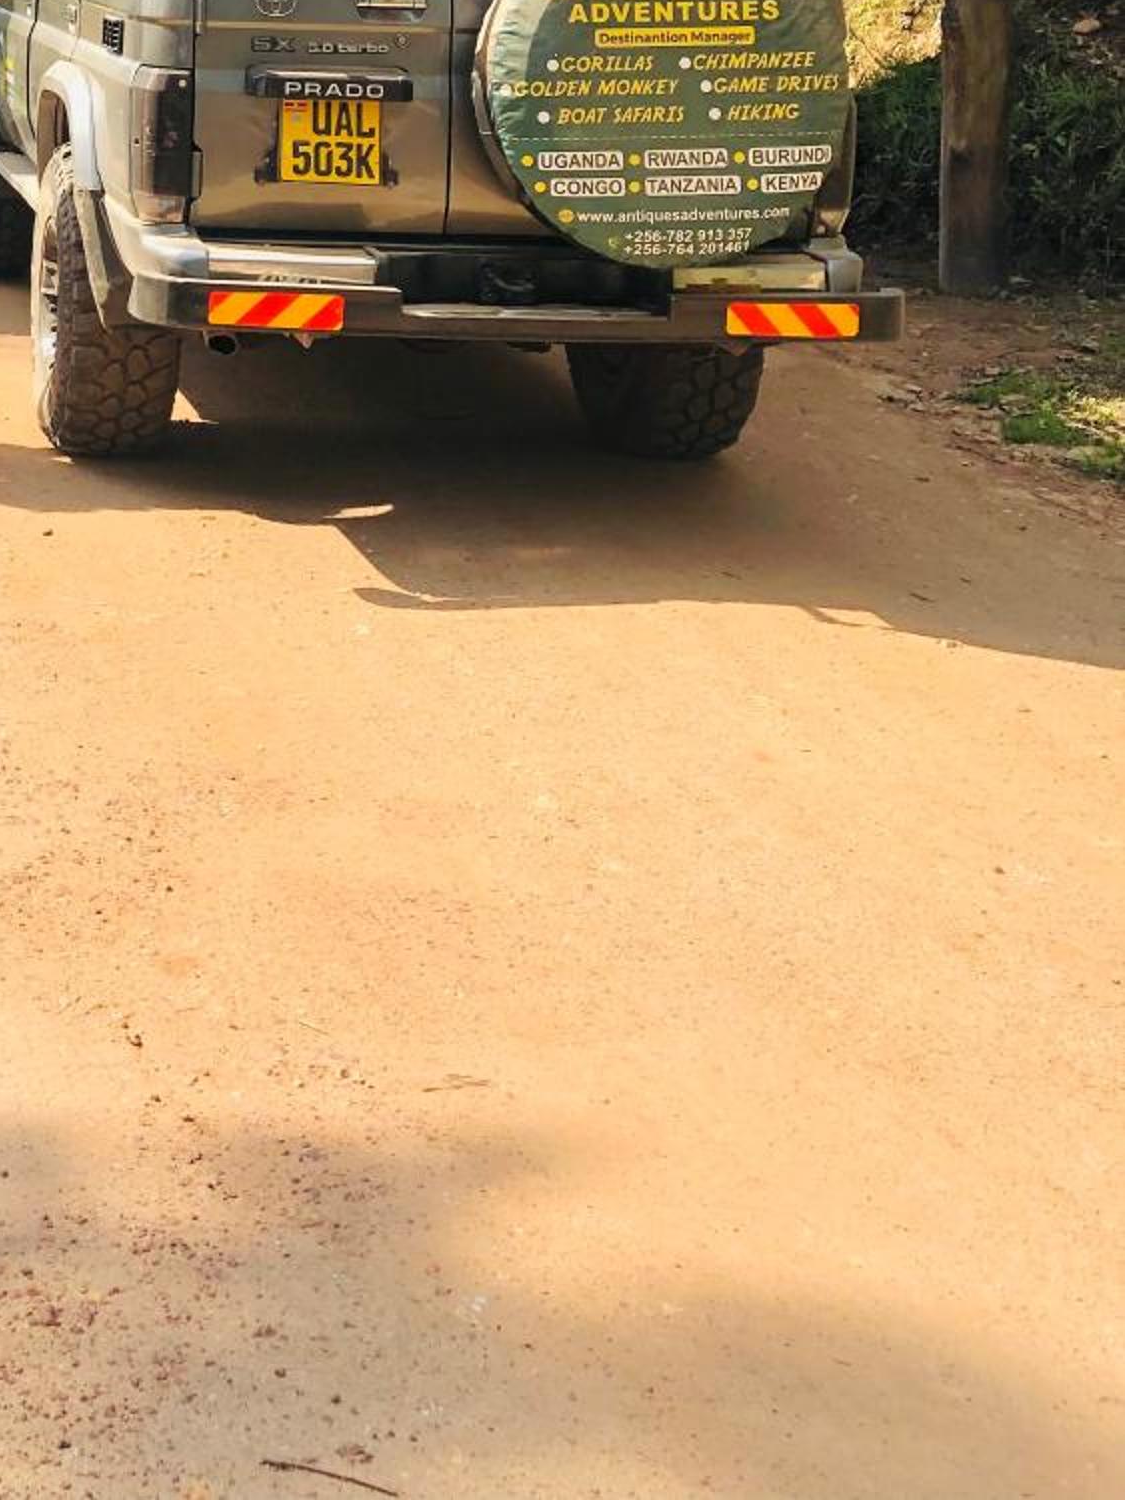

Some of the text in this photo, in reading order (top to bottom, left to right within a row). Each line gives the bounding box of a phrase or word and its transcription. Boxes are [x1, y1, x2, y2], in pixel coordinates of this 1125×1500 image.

[569, 0, 780, 23] ADVENTURES
[251, 36, 295, 52] SX
[599, 30, 752, 46] Destinantion Manager
[561, 55, 653, 73] GORILLAS
[693, 52, 816, 70] CHIMPANZEE
[285, 81, 384, 98] PRADO
[514, 78, 679, 97] GOLDEN MONKEY
[714, 74, 839, 94] GAME DRIVES
[312, 100, 376, 138] UAL
[557, 106, 684, 124] BOAT SAFARIS
[728, 103, 800, 120] HIKING
[292, 140, 376, 178] 503K
[541, 153, 620, 169] UGANDA
[648, 150, 726, 167] RWANDA
[553, 174, 818, 195] CONGO TANZANIA KENYA
[578, 207, 789, 224] www.antiquesadventures.com
[625, 229, 693, 243] +256-782
